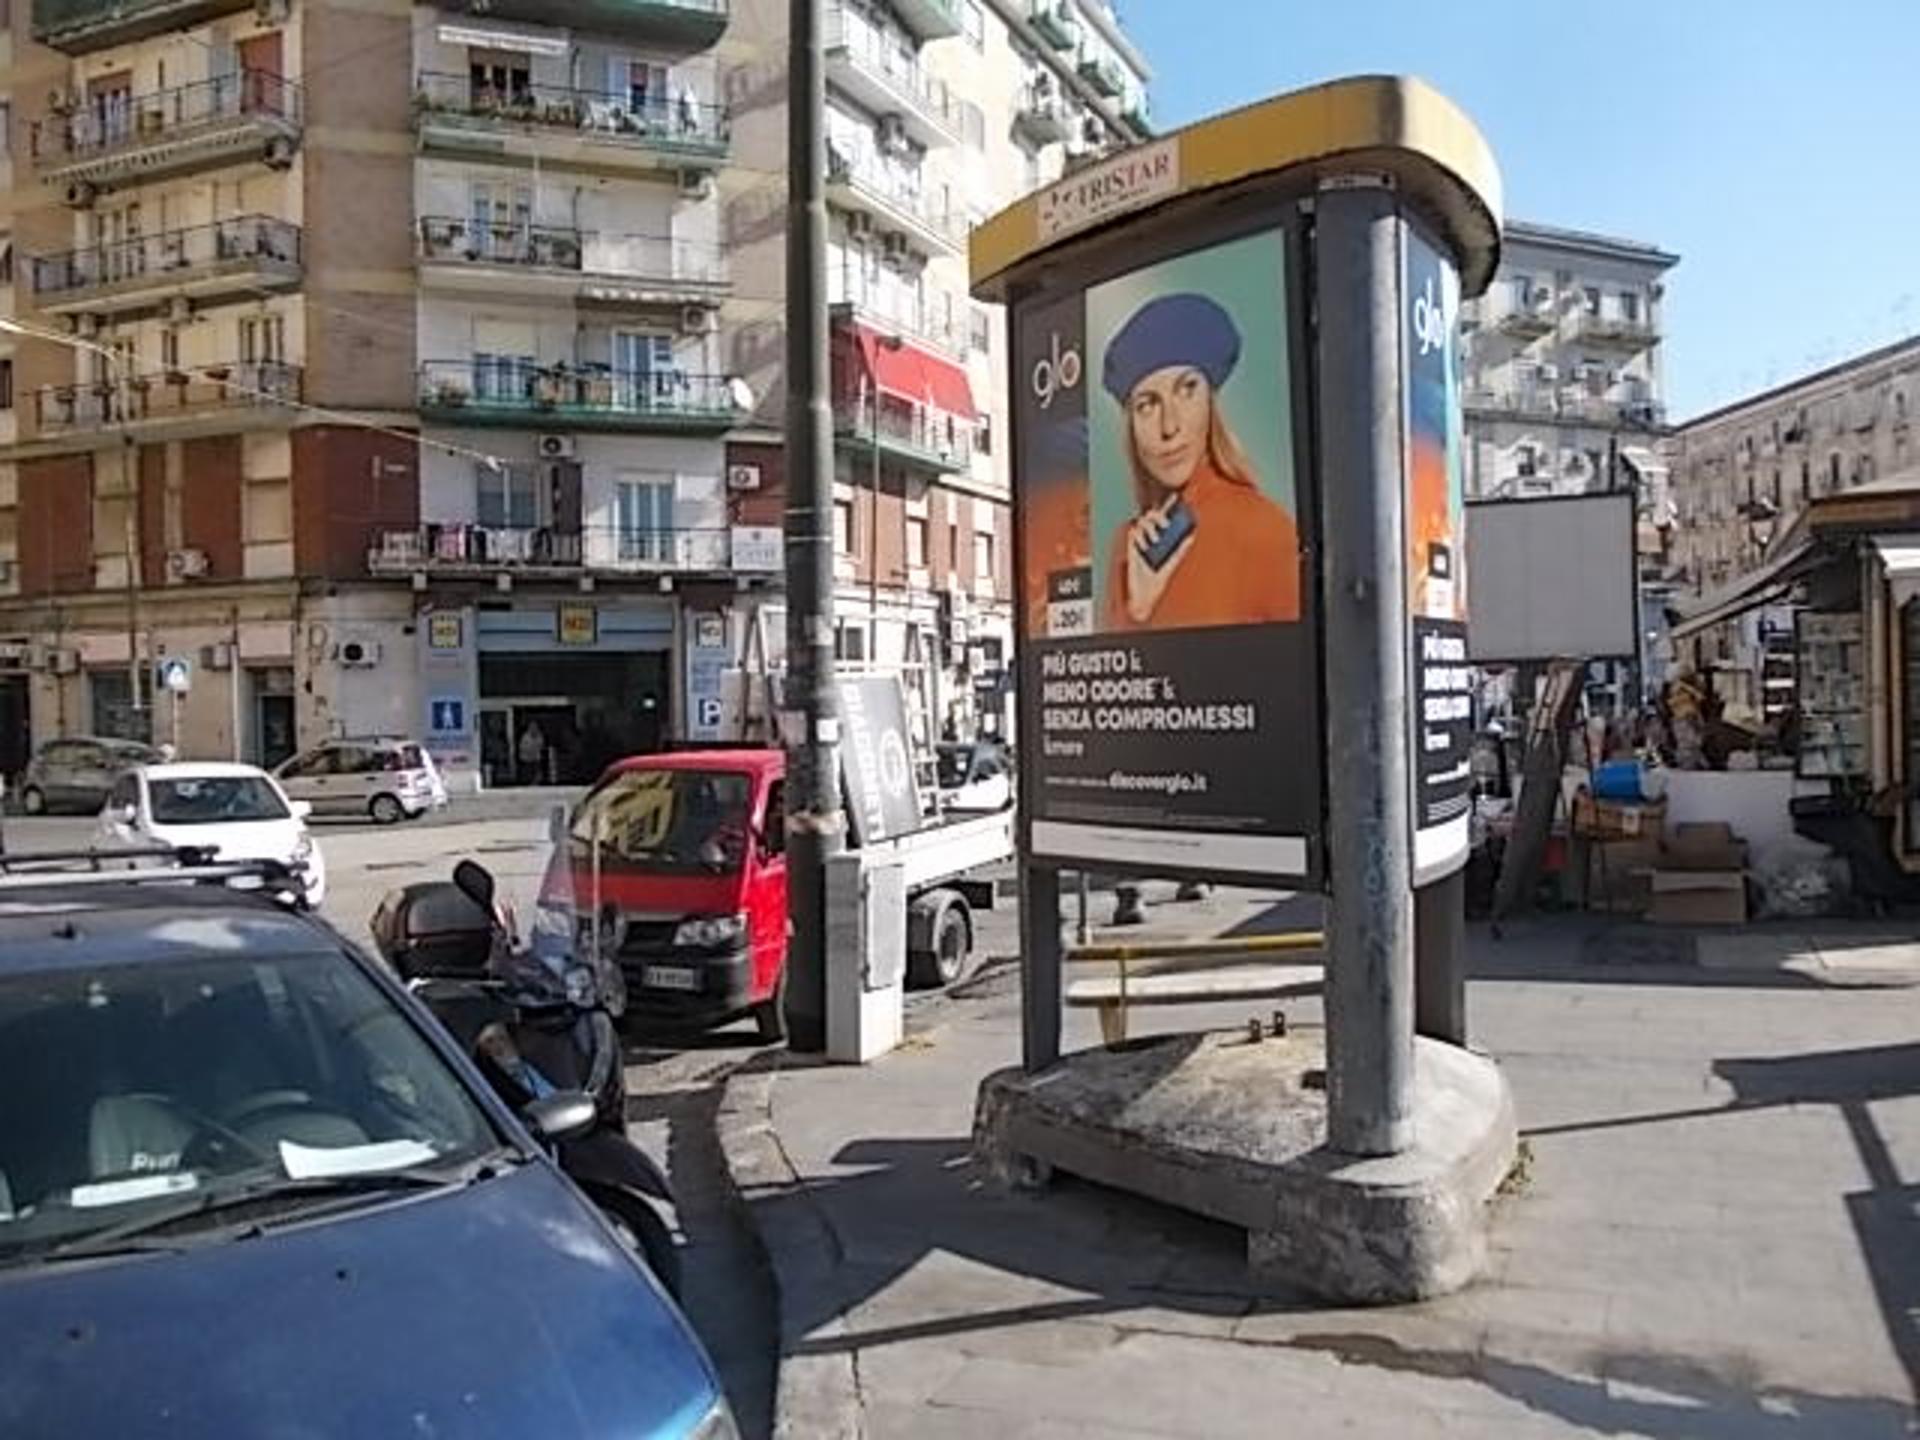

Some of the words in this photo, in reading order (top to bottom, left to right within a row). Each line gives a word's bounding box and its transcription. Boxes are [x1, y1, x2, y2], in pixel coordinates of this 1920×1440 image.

[1033, 331, 1081, 408] glo
[1043, 707, 1093, 729] SENZA
[1094, 704, 1255, 730] COMPROMESSI
